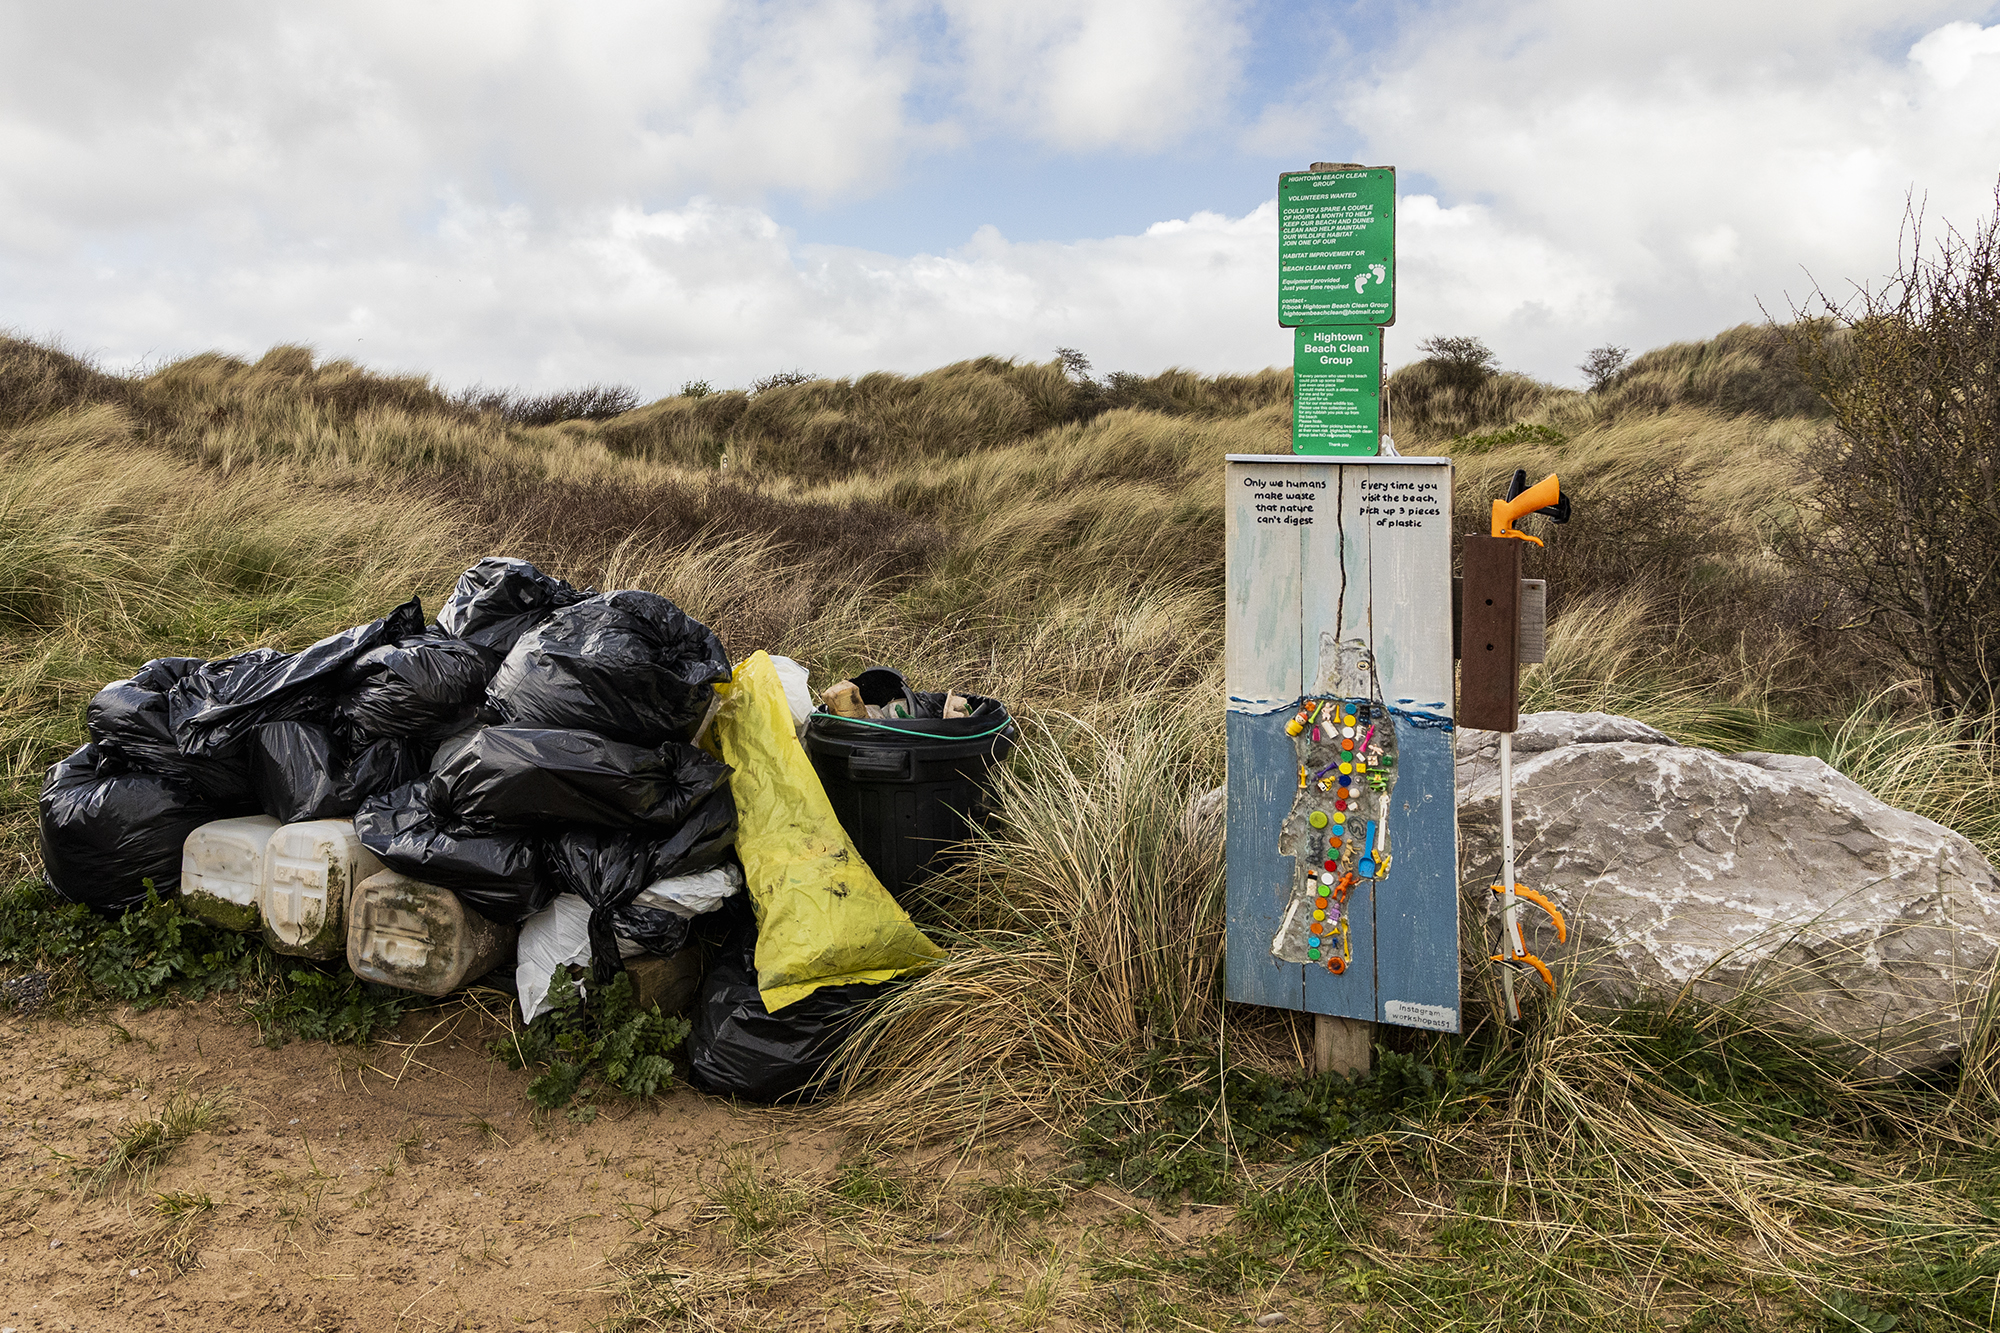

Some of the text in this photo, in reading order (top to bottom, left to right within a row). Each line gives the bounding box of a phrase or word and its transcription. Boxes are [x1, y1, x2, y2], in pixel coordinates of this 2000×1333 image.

[1314, 332, 1363, 343] Hightown
[1304, 344, 1369, 352] Beach Clean
[1320, 356, 1353, 366] Group
[1244, 478, 1266, 489] Only
[1286, 480, 1326, 489] humans
[1361, 480, 1437, 492] Every time you
[1403, 495, 1437, 504] beach,
[1280, 504, 1314, 512] nature
[1360, 507, 1379, 516] pick
[1409, 508, 1440, 516] pieces
[1284, 516, 1313, 526] digest
[1388, 519, 1422, 528] plastic
